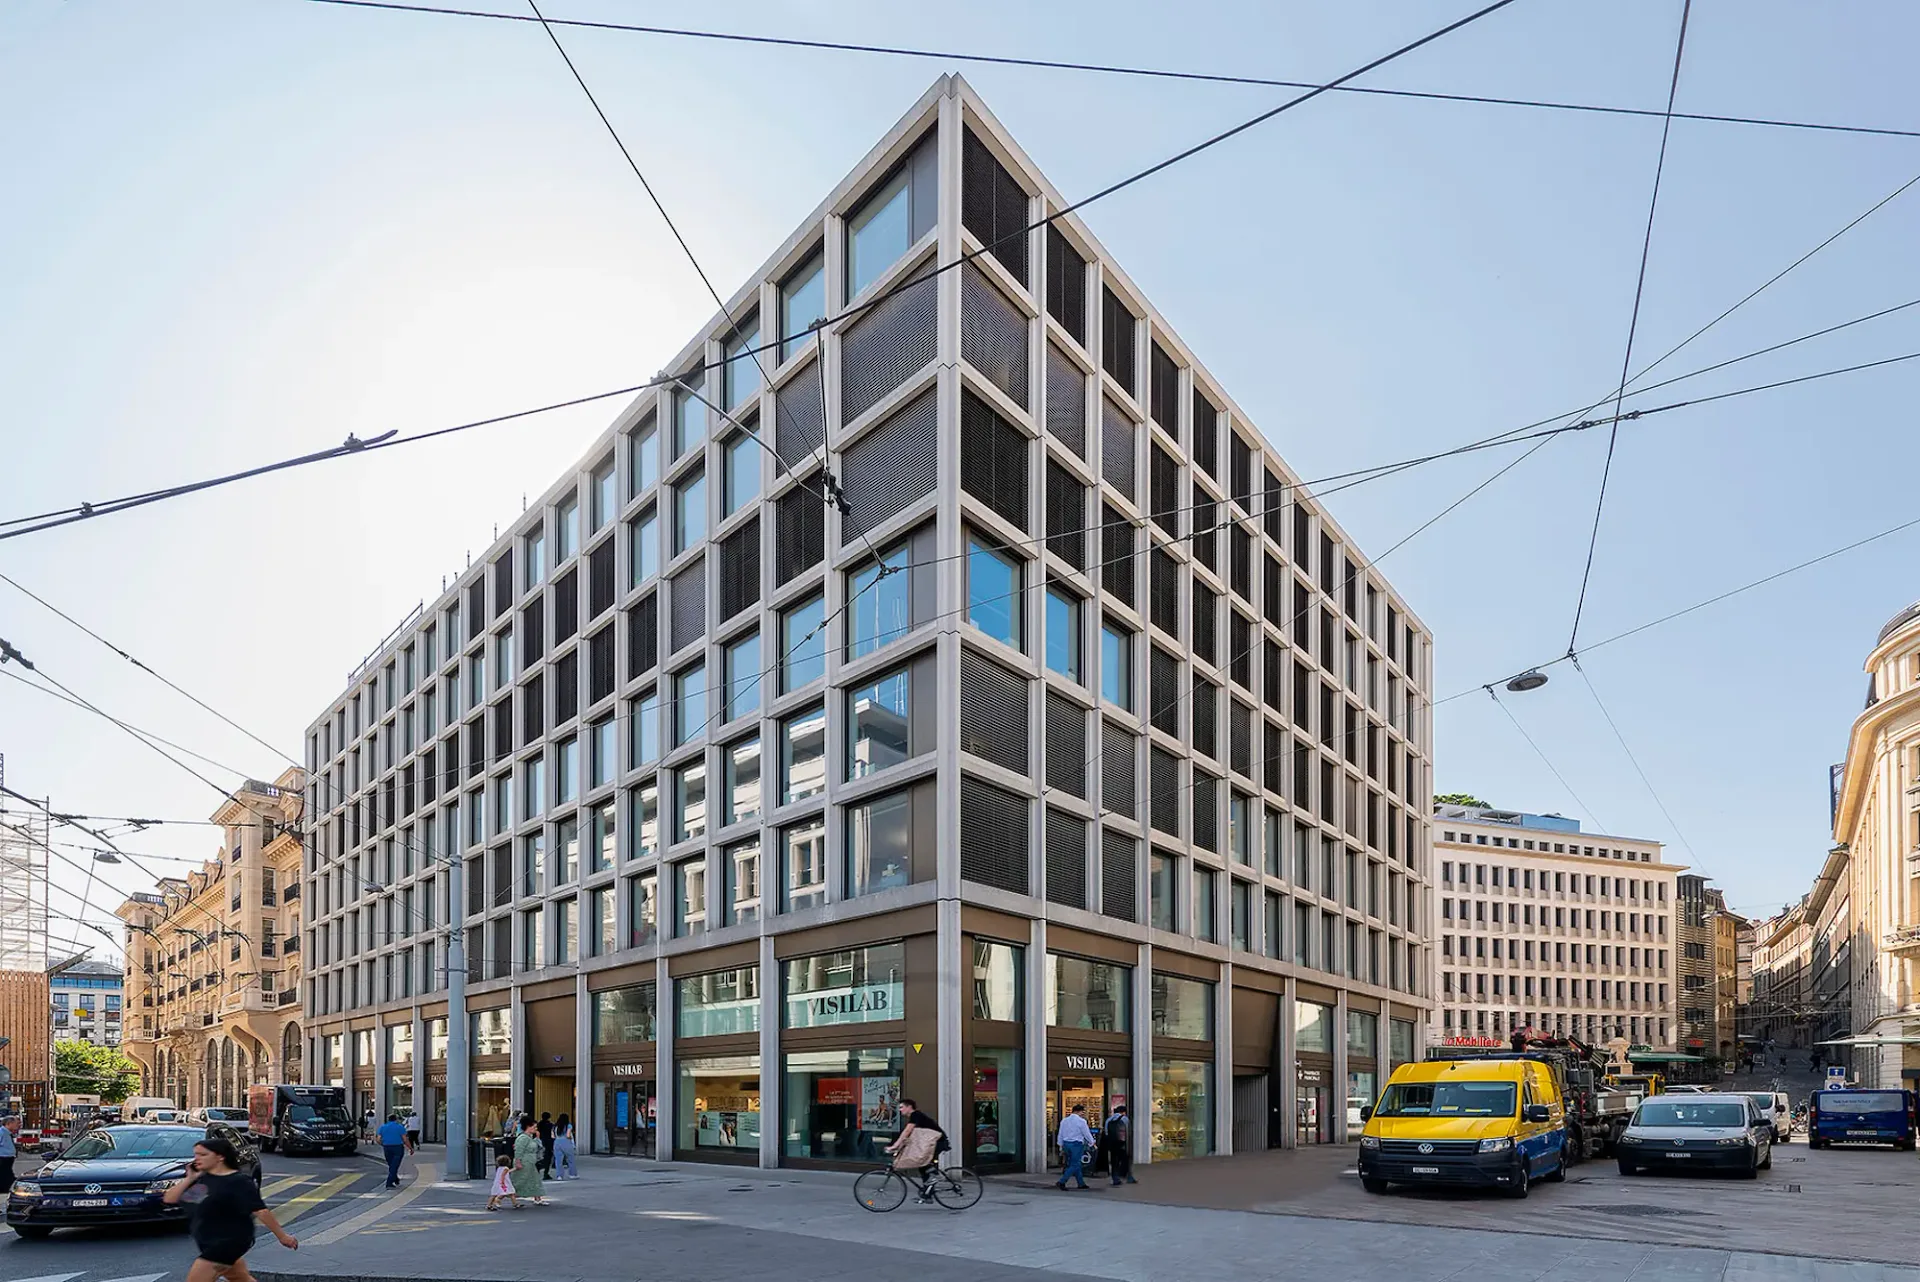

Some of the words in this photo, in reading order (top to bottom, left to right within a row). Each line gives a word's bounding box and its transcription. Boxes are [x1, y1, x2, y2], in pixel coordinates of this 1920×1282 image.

[807, 990, 887, 1016] VISILAB
[612, 1064, 642, 1075] VISILAB
[1066, 1056, 1106, 1070] VISILAB
